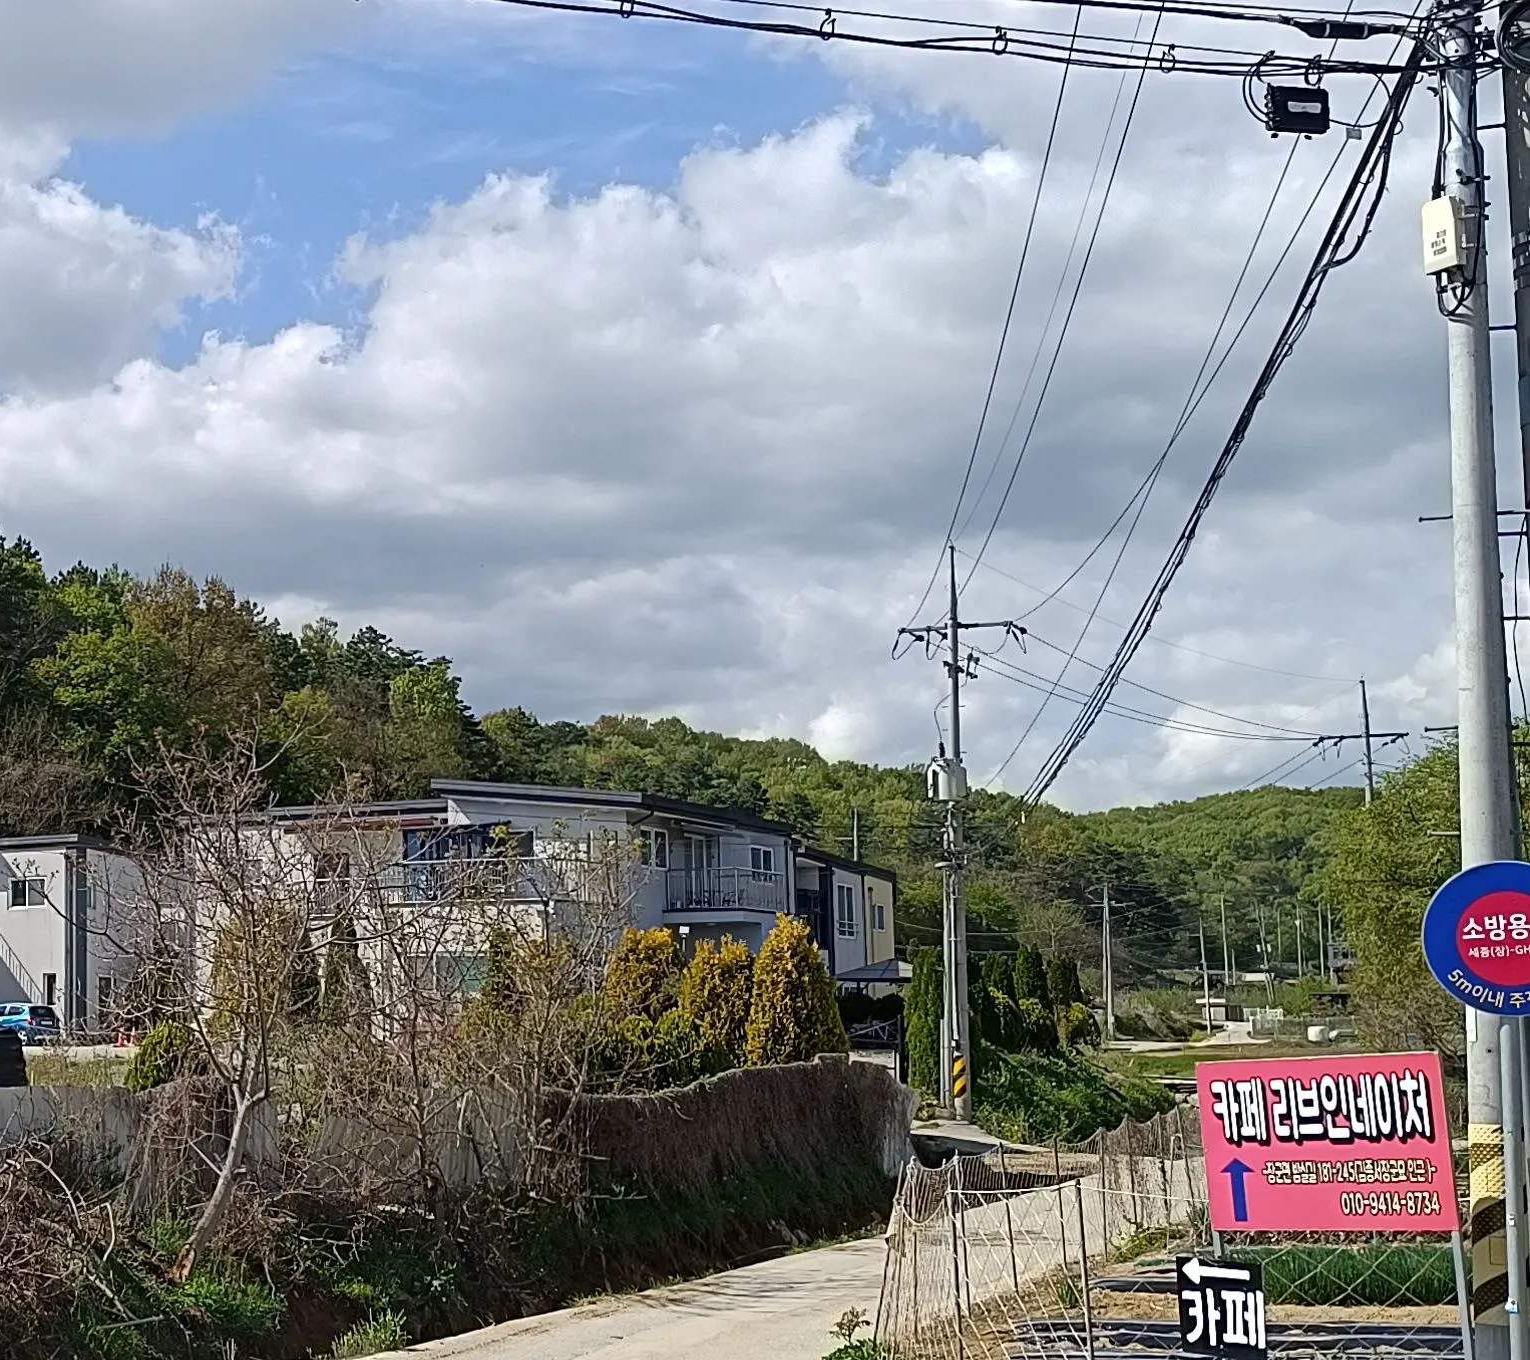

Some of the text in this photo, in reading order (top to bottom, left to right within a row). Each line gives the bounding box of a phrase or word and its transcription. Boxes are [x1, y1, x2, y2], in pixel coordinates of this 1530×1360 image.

[1462, 913, 1530, 941] 소방용
[1447, 969, 1505, 1008] 5m이내
[1210, 1068, 1432, 1143] 카페 리브인네이처
[1340, 1191, 1441, 1215] 010-9414-8734
[1181, 1287, 1266, 1349] 카페
